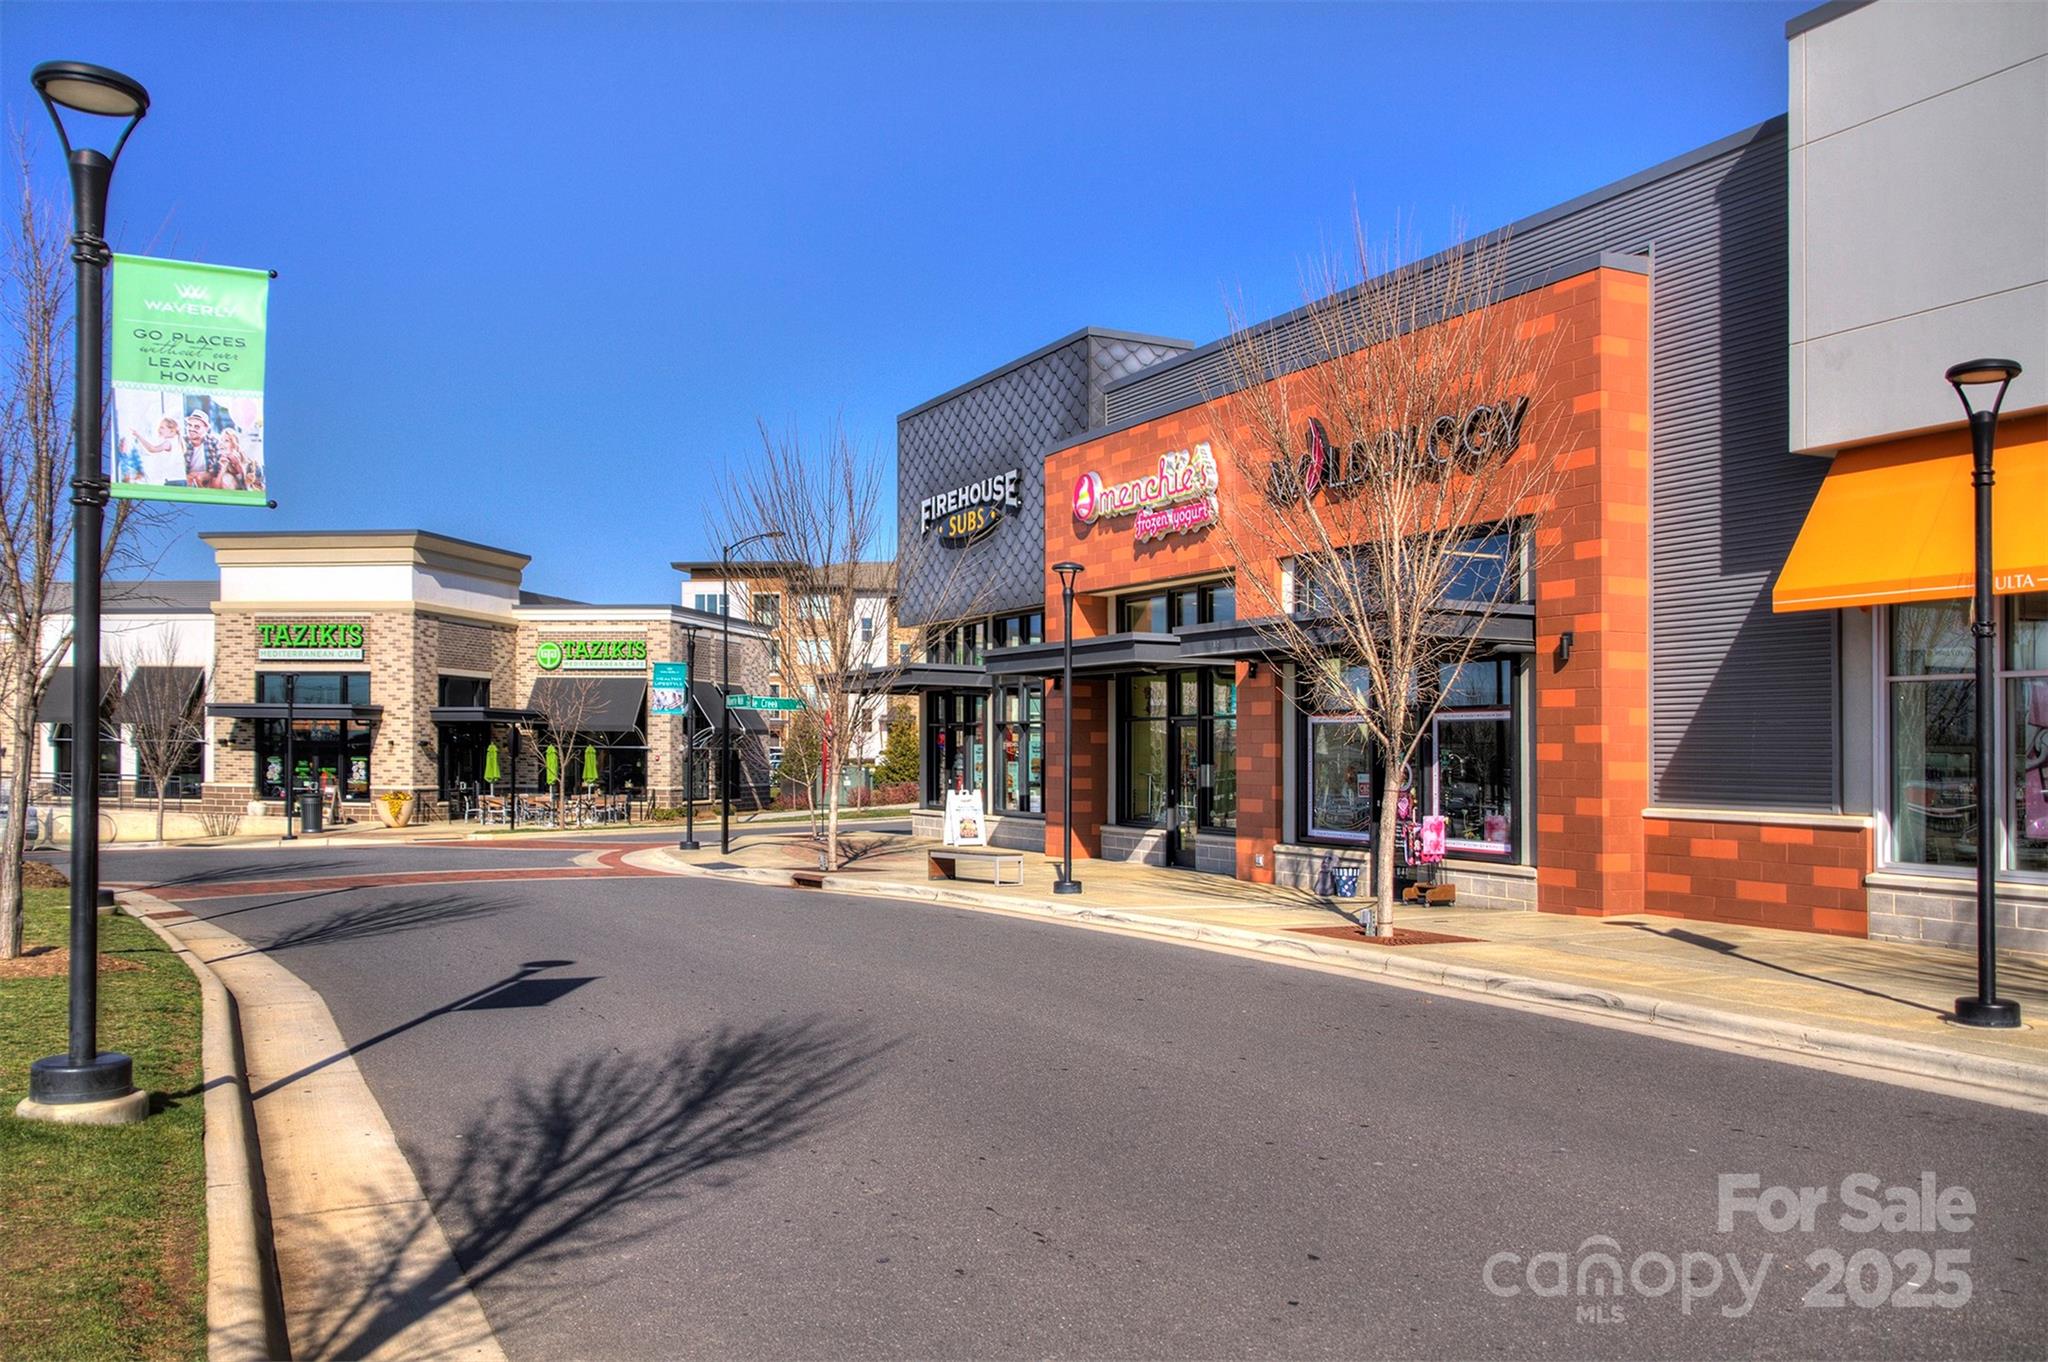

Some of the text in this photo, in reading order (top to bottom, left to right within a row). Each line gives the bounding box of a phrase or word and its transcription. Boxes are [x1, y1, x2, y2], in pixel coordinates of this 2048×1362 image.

[133, 328, 247, 348] GO PLACES
[139, 340, 213, 358] without
[148, 357, 231, 373] LEAVING
[160, 370, 219, 385] HOME
[921, 469, 1018, 535] FIREHOUSE
[949, 508, 985, 537] SUBS
[1136, 500, 1211, 539] frozen yogurt
[1995, 573, 2036, 591] ULTA
[260, 650, 335, 658] MEDITERRANEAN
